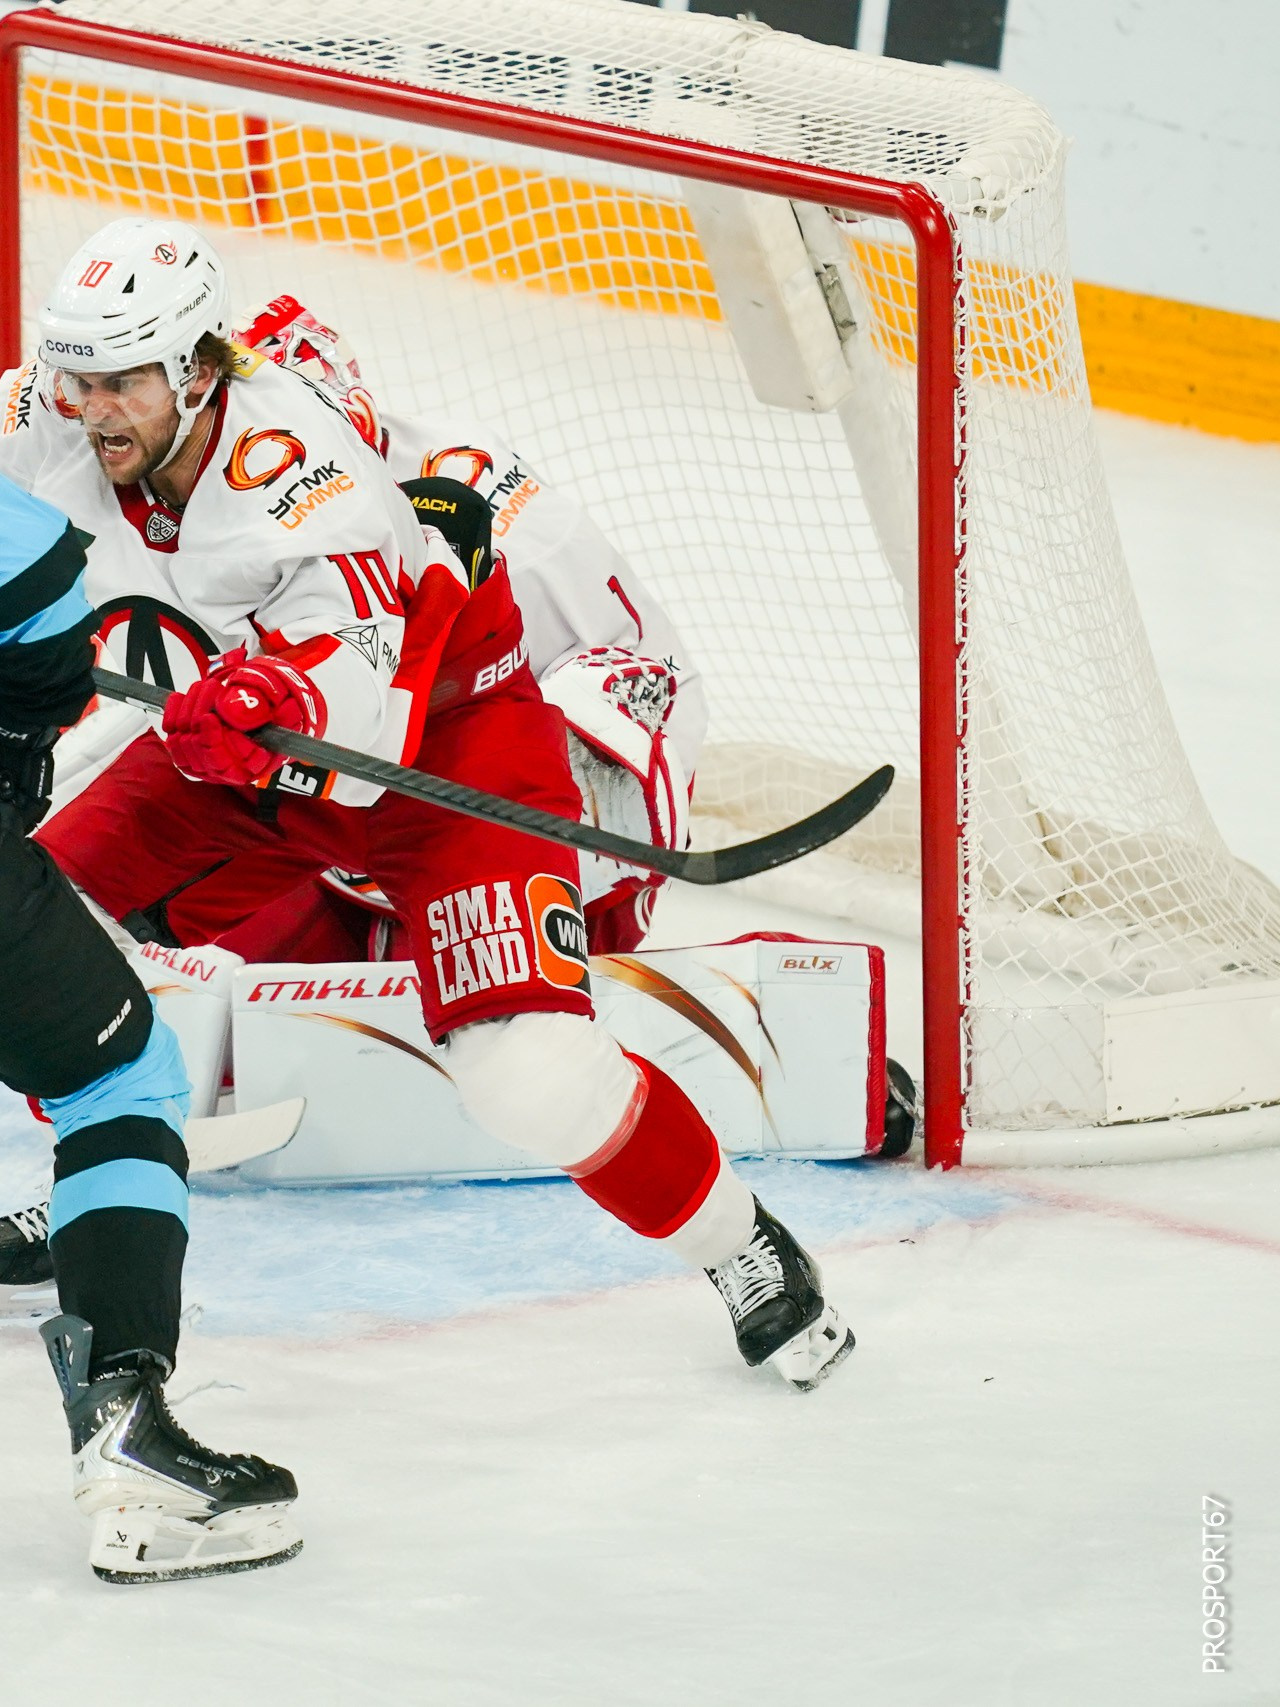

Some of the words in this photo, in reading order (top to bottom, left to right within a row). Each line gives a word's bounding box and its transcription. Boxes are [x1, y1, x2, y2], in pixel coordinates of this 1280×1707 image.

[77, 260, 113, 289] 10
[280, 474, 355, 531] UMMC
[329, 549, 406, 621] 10
[427, 881, 522, 952] SIMA
[141, 940, 217, 982] IKLIN
[433, 931, 531, 1006] LAND
[783, 956, 837, 973] BLIX
